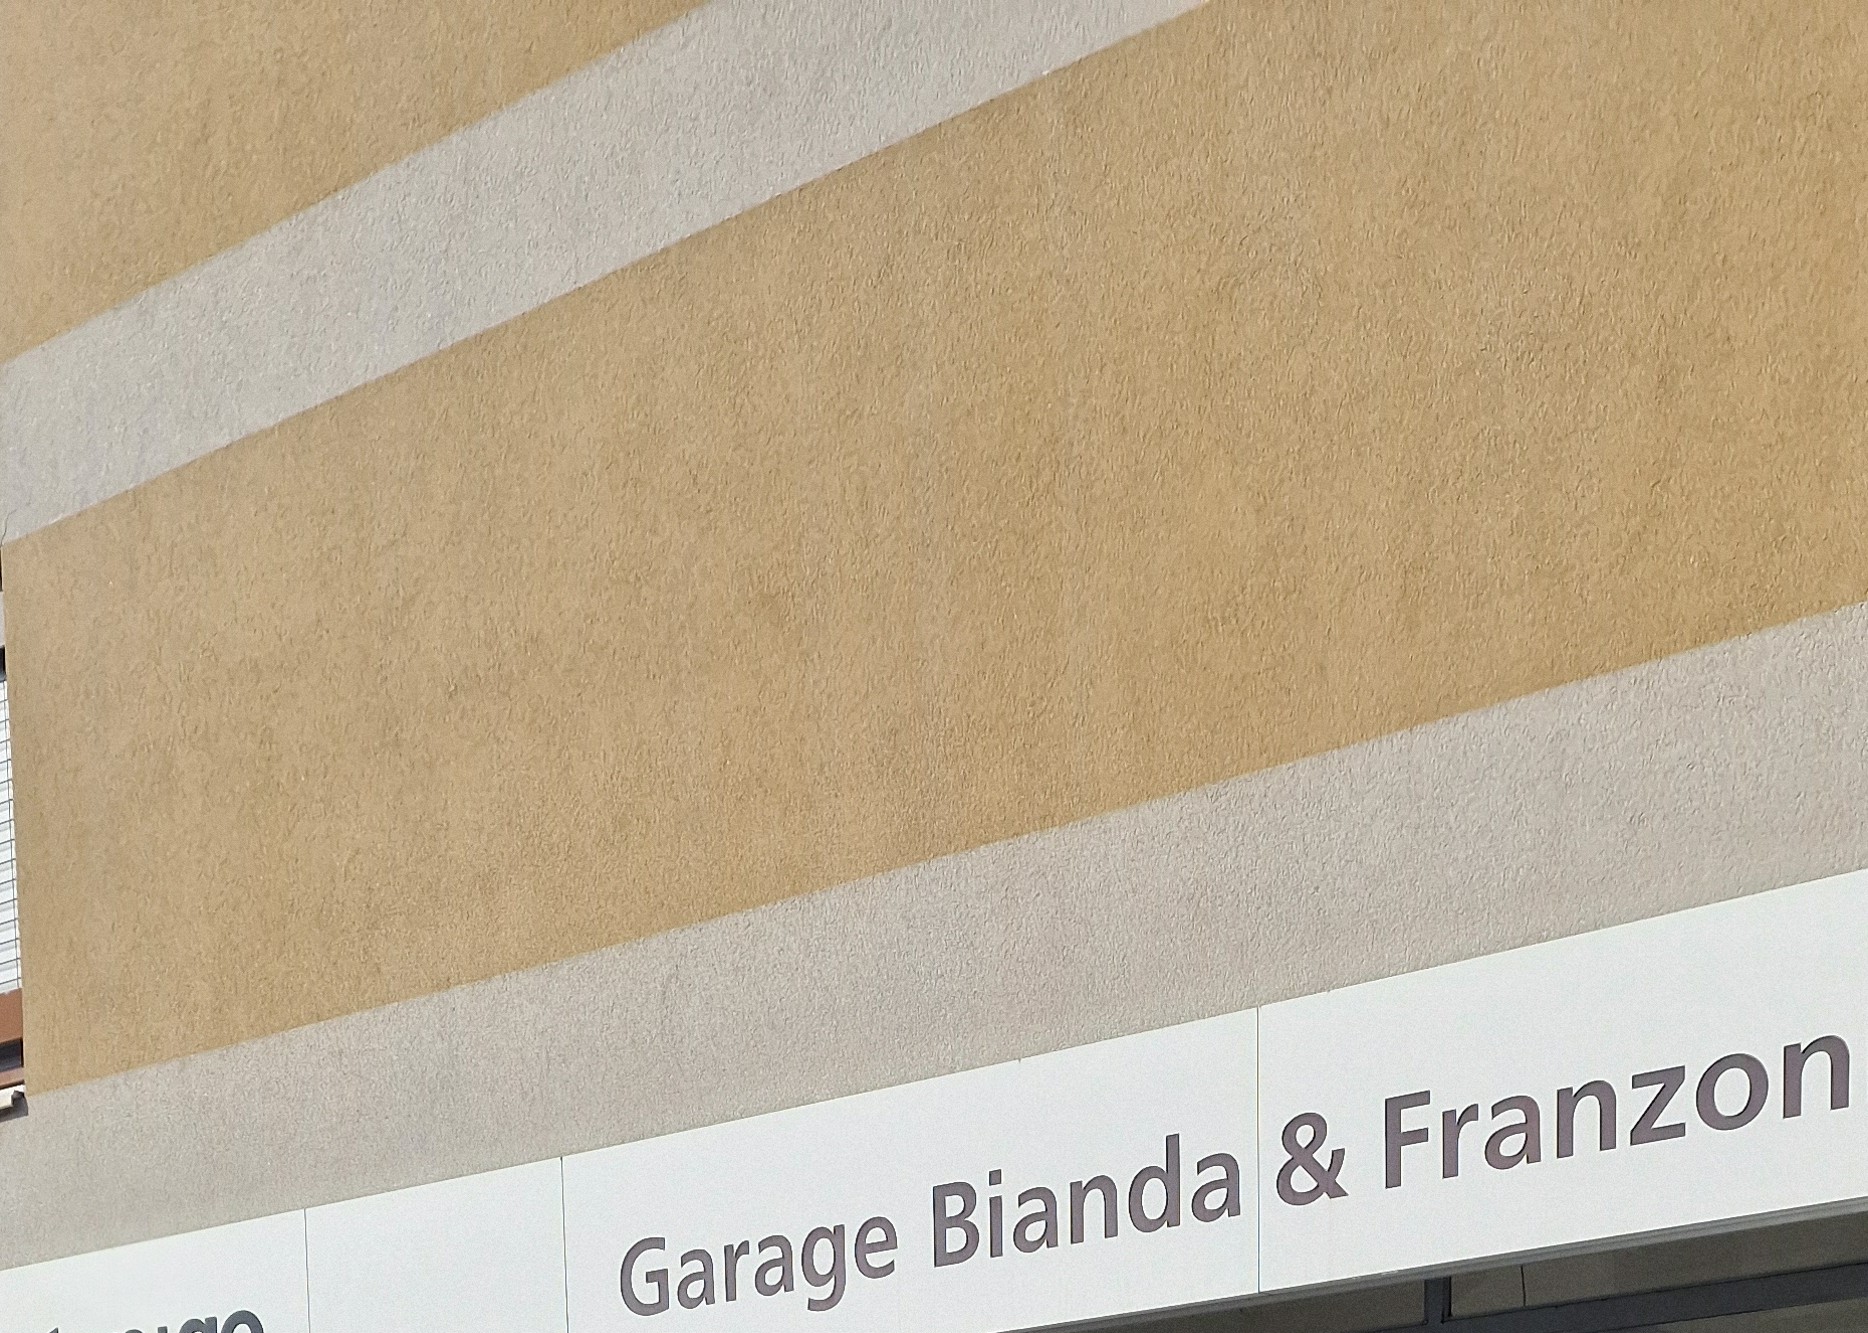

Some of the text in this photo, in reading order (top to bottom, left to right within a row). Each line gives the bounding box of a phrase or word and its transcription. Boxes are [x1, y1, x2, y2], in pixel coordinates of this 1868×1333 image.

[619, 1039, 1851, 1317] Garage Bianda & Franzon
